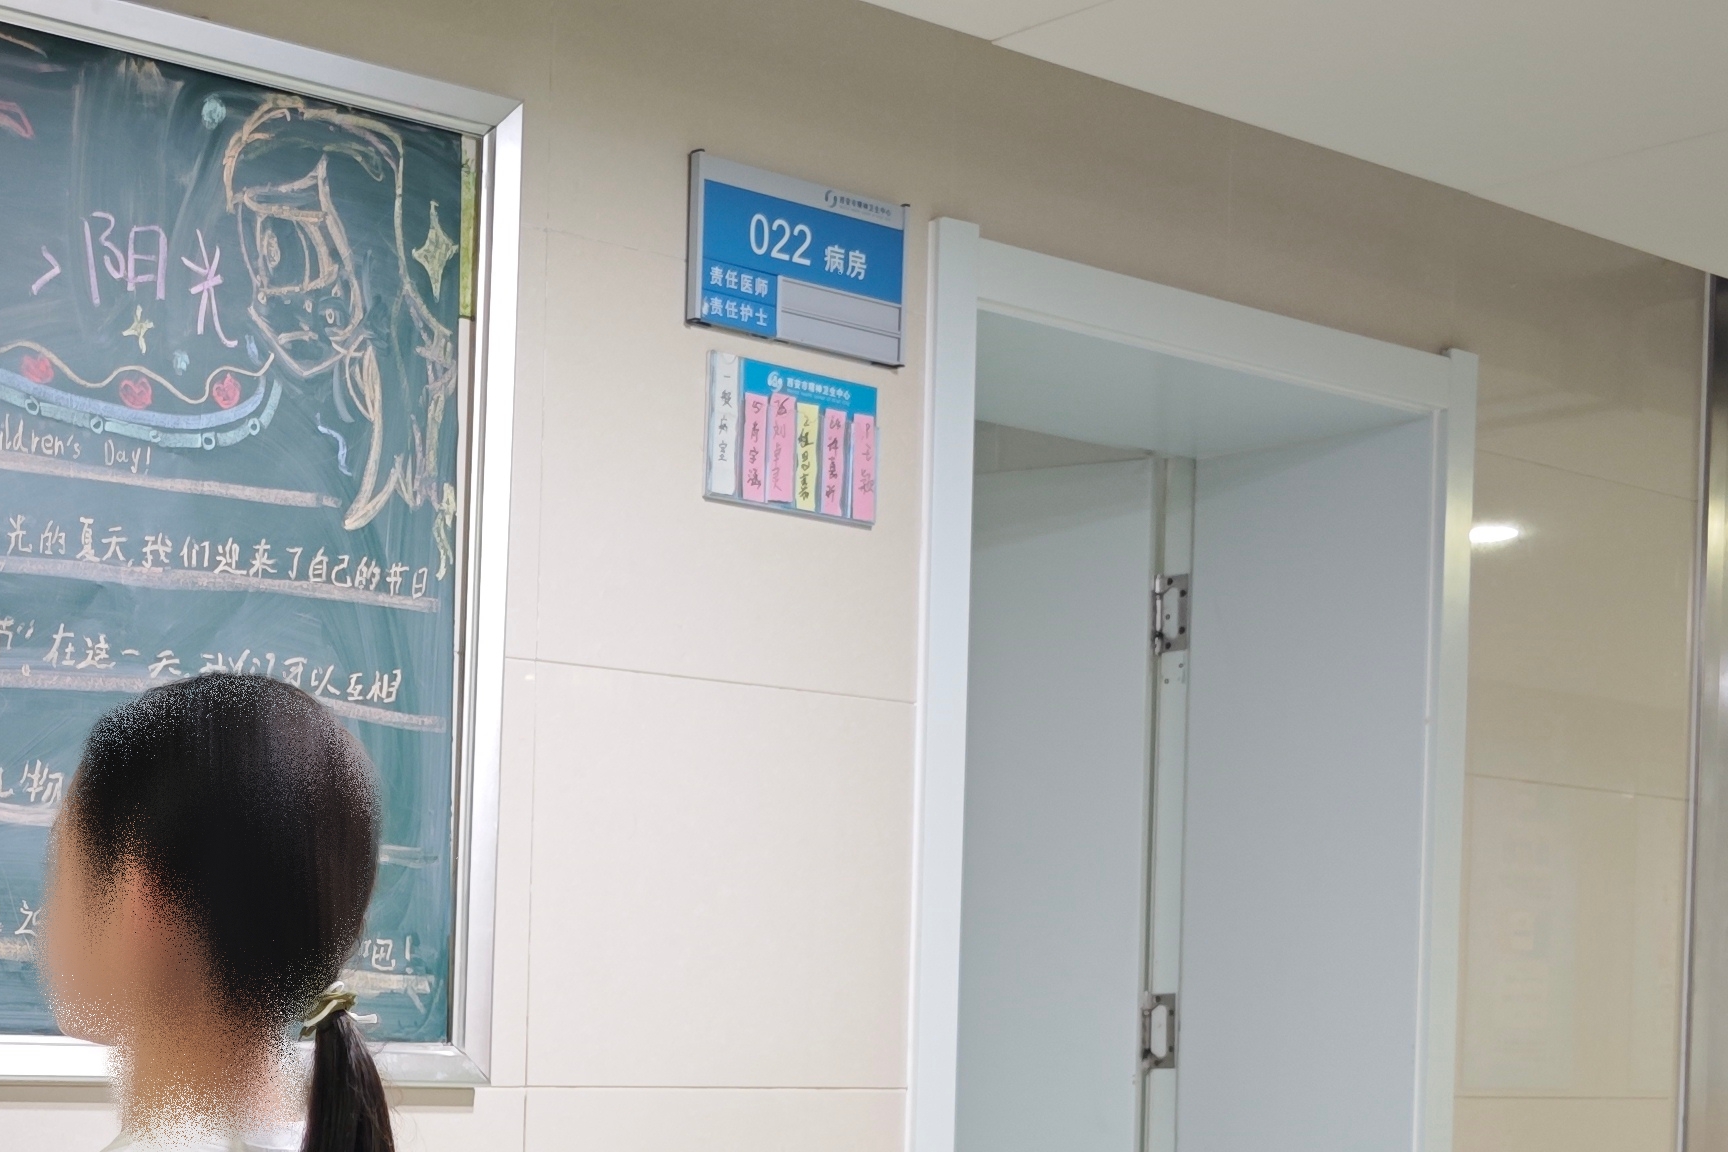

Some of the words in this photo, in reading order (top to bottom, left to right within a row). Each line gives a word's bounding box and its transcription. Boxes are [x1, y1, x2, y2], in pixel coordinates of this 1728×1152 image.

[749, 213, 812, 267] 022
[824, 244, 868, 282] 病房
[83, 210, 238, 348] 阳光
[709, 264, 769, 298] 责任医师
[709, 296, 769, 327] 责任护士
